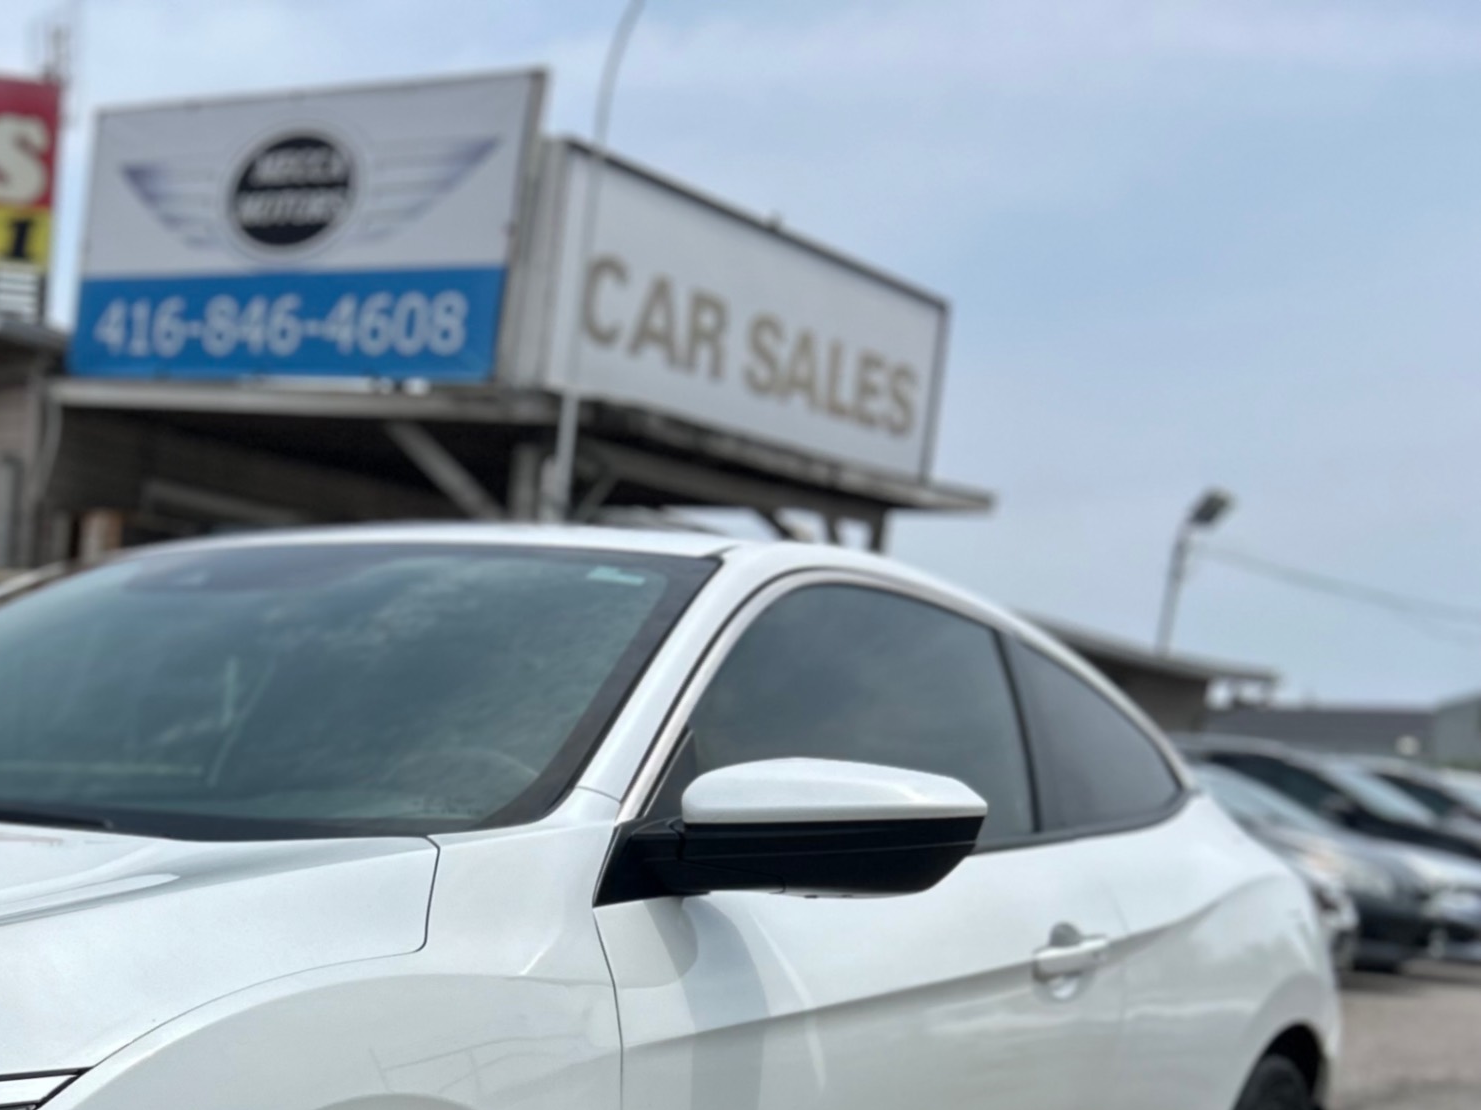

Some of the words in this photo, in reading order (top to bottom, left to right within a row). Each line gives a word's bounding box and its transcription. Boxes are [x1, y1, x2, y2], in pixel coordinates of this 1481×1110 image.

[237, 187, 349, 228] MOTORS
[95, 289, 468, 358] 416-846-4608
[580, 253, 730, 381] CAR
[742, 312, 919, 438] SALES
